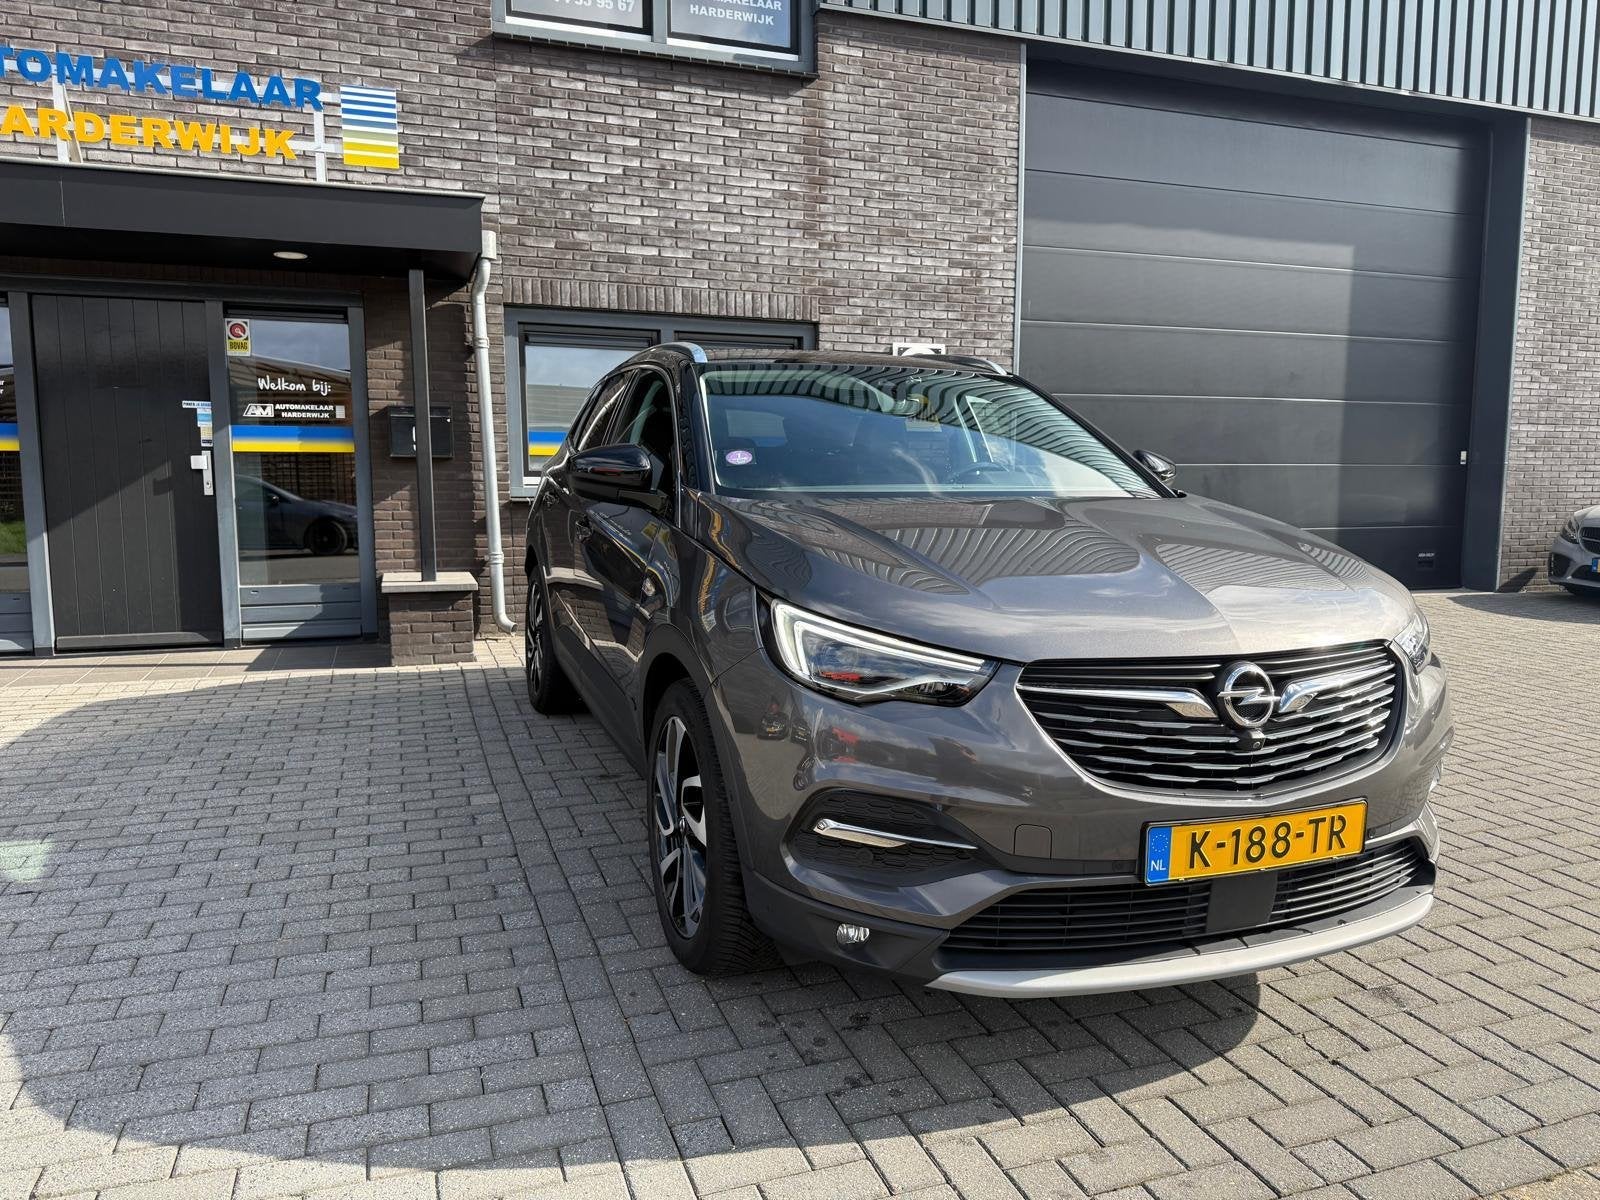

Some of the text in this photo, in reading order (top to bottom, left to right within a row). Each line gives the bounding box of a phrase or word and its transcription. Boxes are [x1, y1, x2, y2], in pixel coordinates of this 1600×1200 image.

[690, 4, 774, 25] HARDERWIJK
[713, 0, 782, 10] ELAAR
[0, 104, 298, 159] ARDERWIJK
[257, 375, 331, 396] Welkom bij:
[1189, 814, 1347, 868] K-188-TR
[1150, 859, 1166, 871] NL
